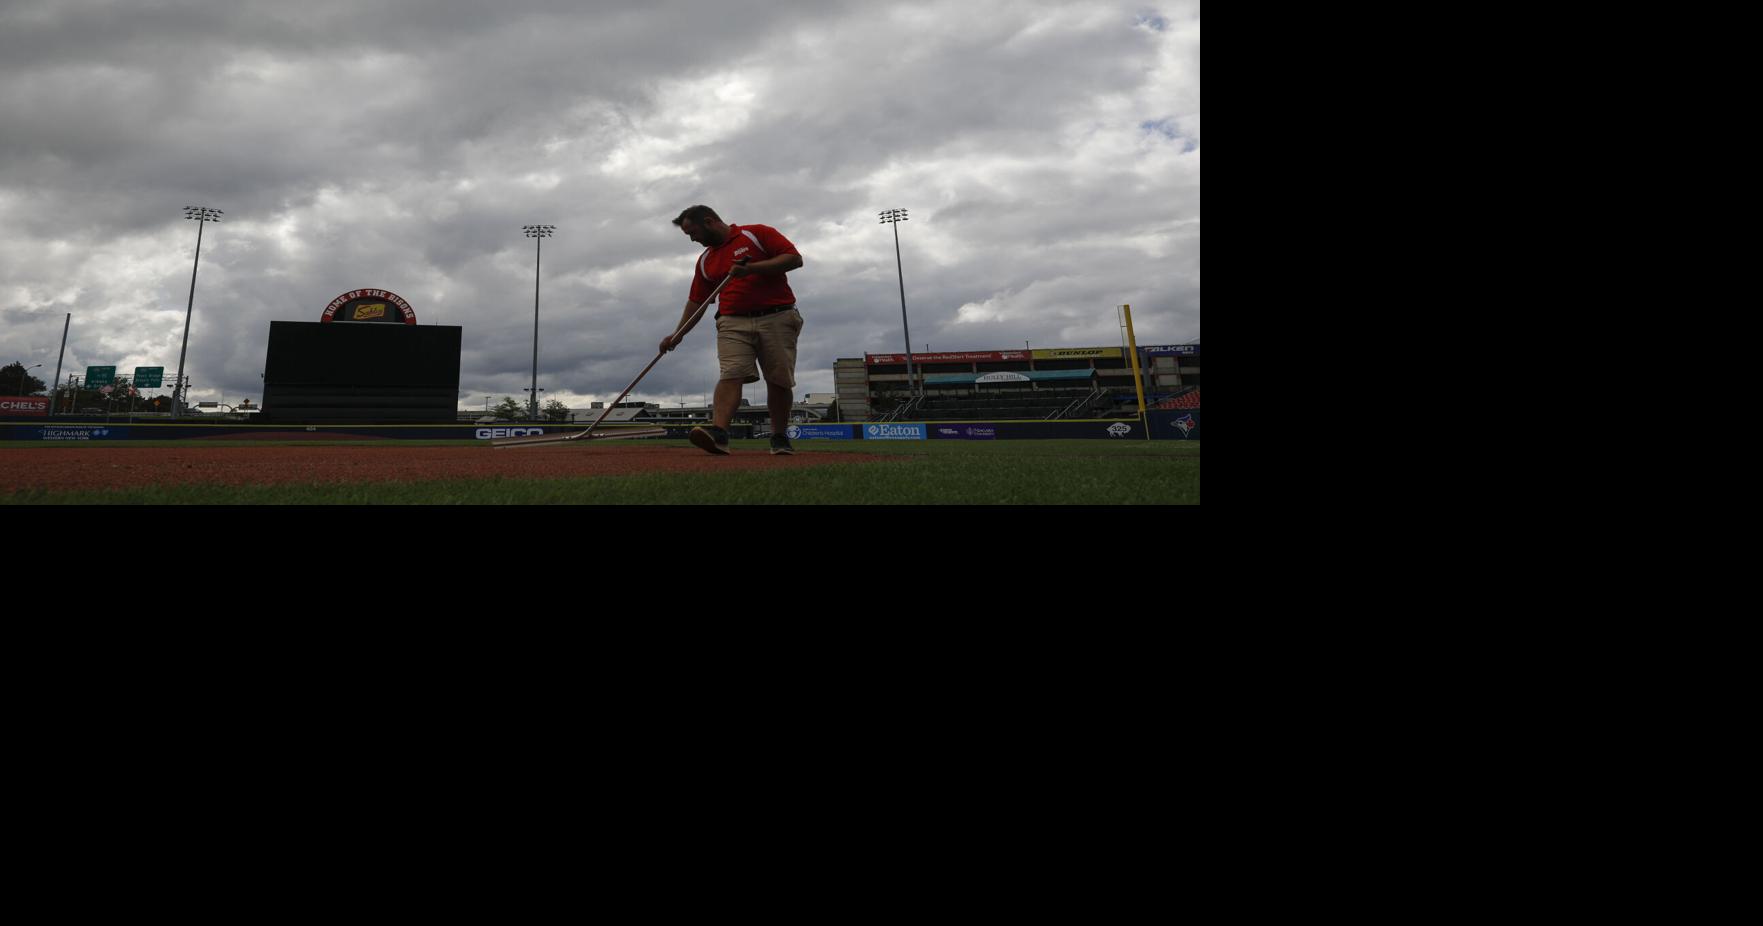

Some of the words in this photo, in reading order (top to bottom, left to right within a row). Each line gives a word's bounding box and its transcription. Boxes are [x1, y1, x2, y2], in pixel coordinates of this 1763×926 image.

[325, 295, 347, 317] HOME
[349, 290, 362, 299] OF
[365, 290, 385, 298] THE
[388, 294, 414, 319] BISONS
[476, 428, 544, 439] GEICO
[880, 424, 921, 436] Eaton
